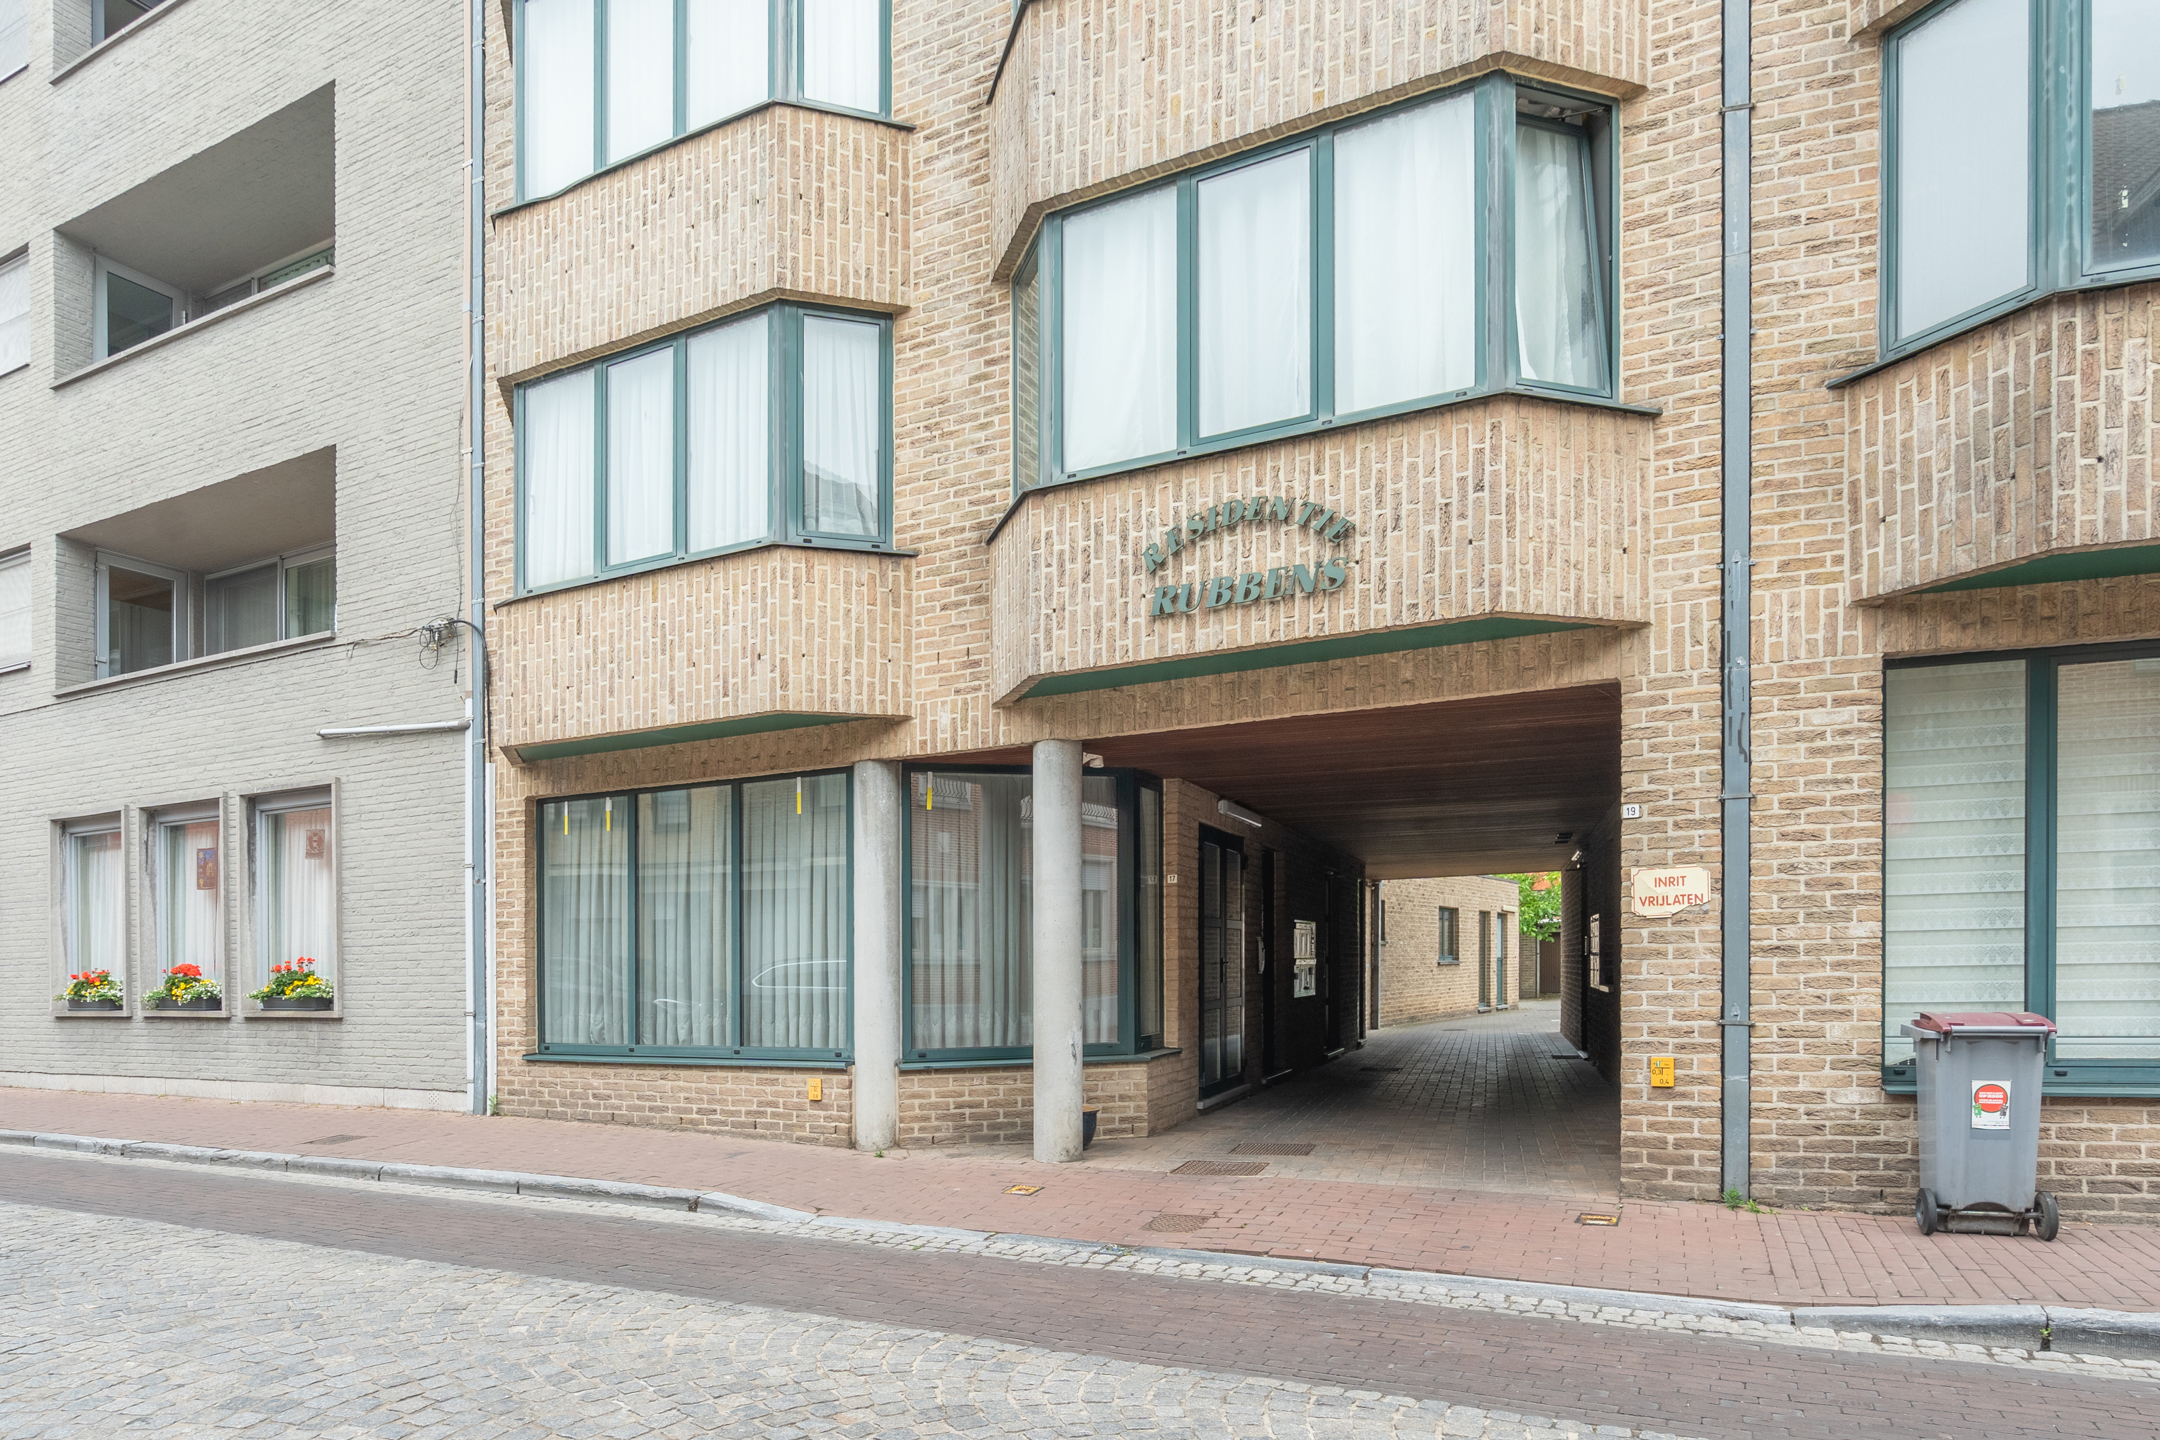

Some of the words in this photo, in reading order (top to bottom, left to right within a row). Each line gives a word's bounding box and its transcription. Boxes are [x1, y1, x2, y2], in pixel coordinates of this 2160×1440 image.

[1141, 495, 1355, 574] RESIDENTIE
[1150, 556, 1349, 617] RUBBENS
[1626, 806, 1636, 816] 19
[1654, 875, 1687, 888] INRIT
[1639, 893, 1704, 907] VRIJLATEN
